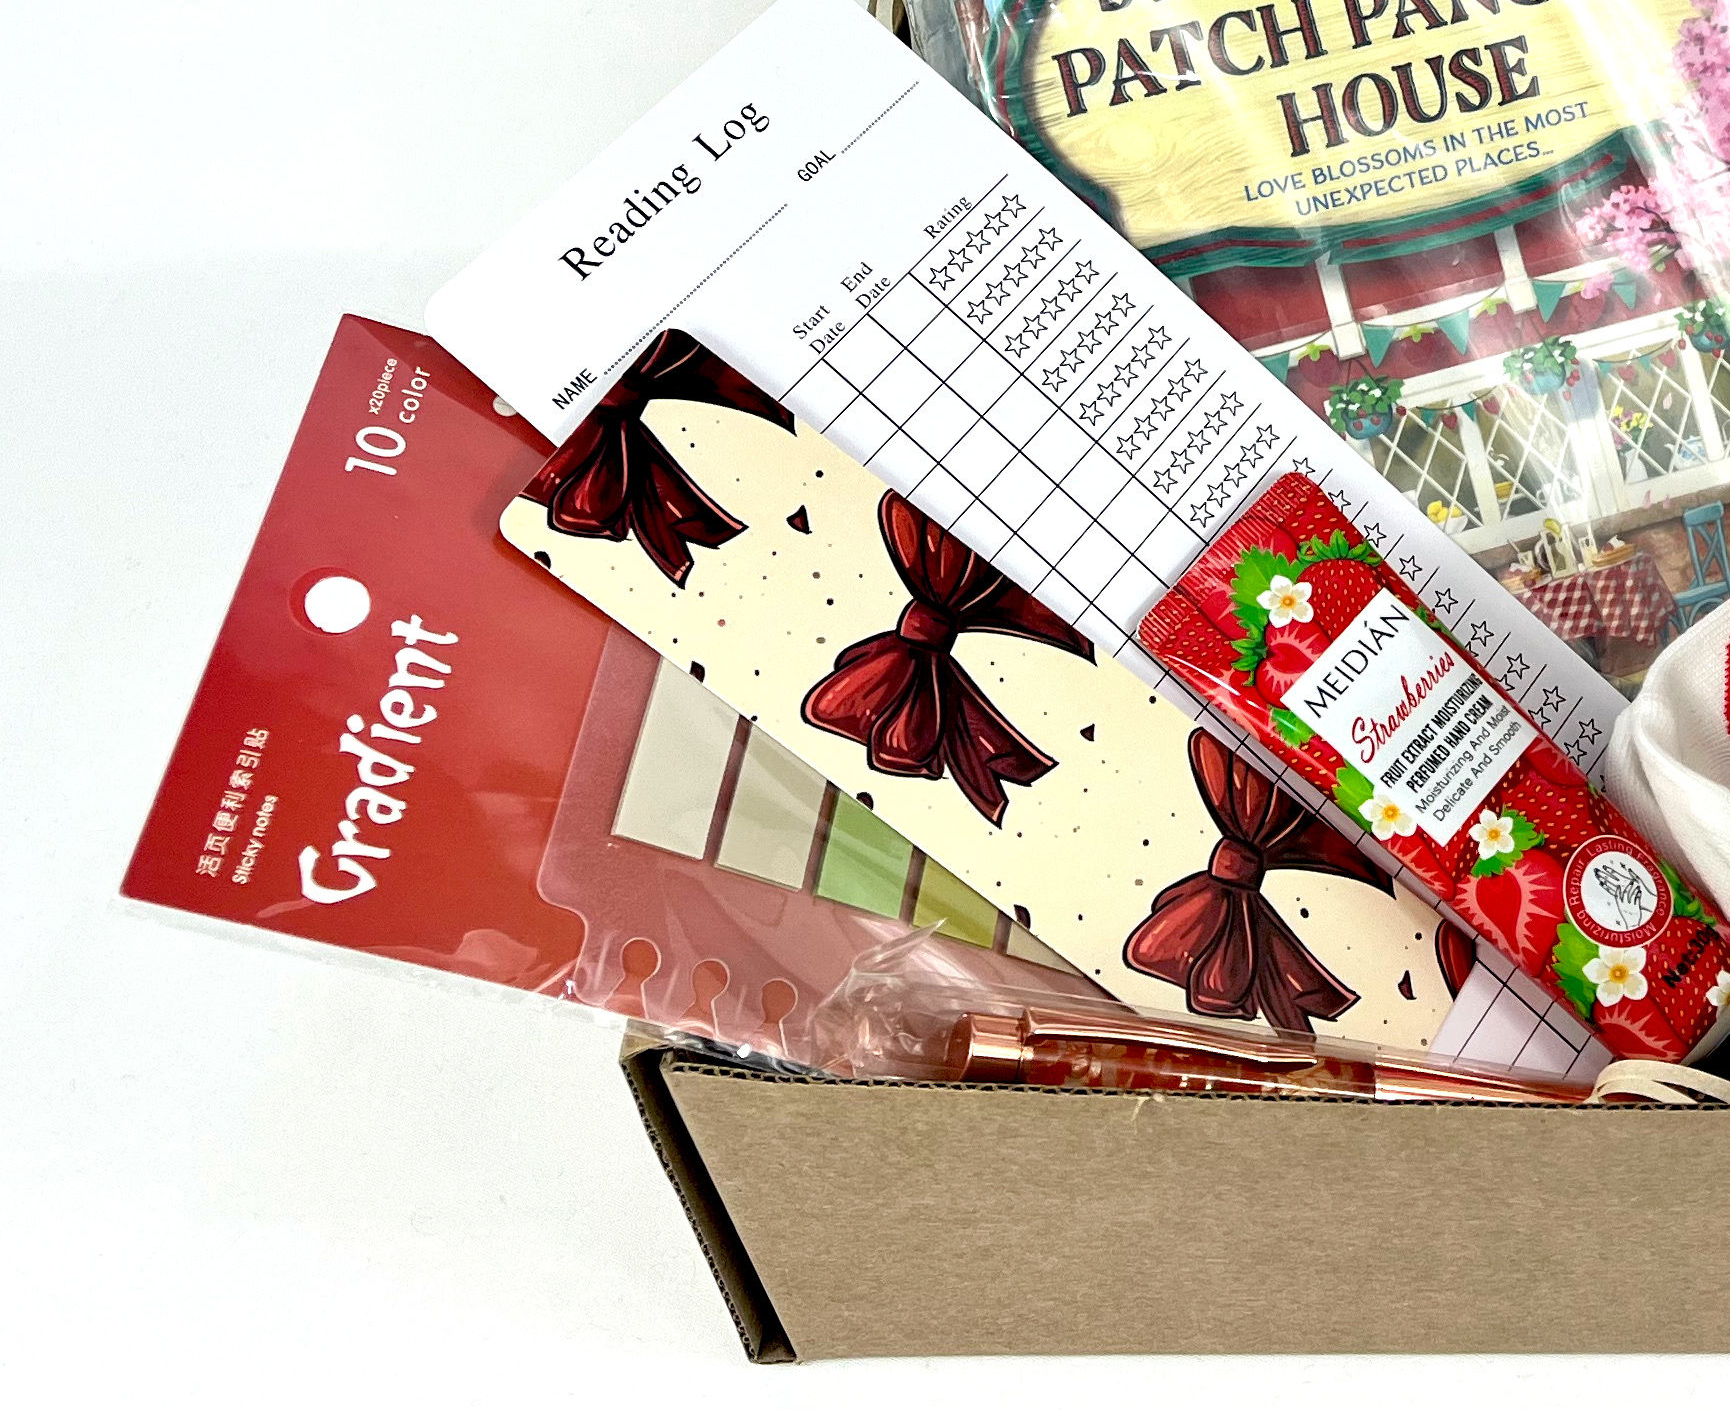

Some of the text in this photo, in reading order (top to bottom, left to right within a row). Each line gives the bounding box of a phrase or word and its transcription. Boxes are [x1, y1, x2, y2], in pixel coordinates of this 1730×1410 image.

[1276, 35, 1540, 158] HOUSE
[798, 151, 836, 181] GOAL
[1244, 101, 1590, 202] LOVE BLOSSOMS IN THE MOST
[559, 103, 769, 281] Reading Log
[924, 195, 972, 240] Rating
[1295, 165, 1448, 216] UNEXPECTED
[841, 263, 872, 292] End
[855, 274, 891, 311] Date
[792, 303, 831, 341] Start
[809, 318, 846, 355] Date
[368, 357, 398, 415] x20piece
[399, 367, 431, 424] color
[552, 369, 597, 409] NAME
[345, 425, 407, 476] 10
[1304, 605, 1409, 718] MEIDIÁN
[1352, 652, 1454, 763] Strawberries
[1380, 673, 1483, 788] FRUIT EXTRACT MOISTURIZING
[299, 615, 458, 903] Gradient
[1406, 695, 1493, 793] PERFUMED HAND CREAM
[1415, 705, 1510, 813] Moisturizing And Moist
[1433, 722, 1521, 821] Delicate And Smooth
[195, 727, 270, 876] 活页便利索引贴
[232, 795, 278, 884] Sticky notes
[1585, 839, 1633, 856] Lasting
[1568, 859, 1584, 906] Repair
[1576, 909, 1656, 944] Moisturizing
